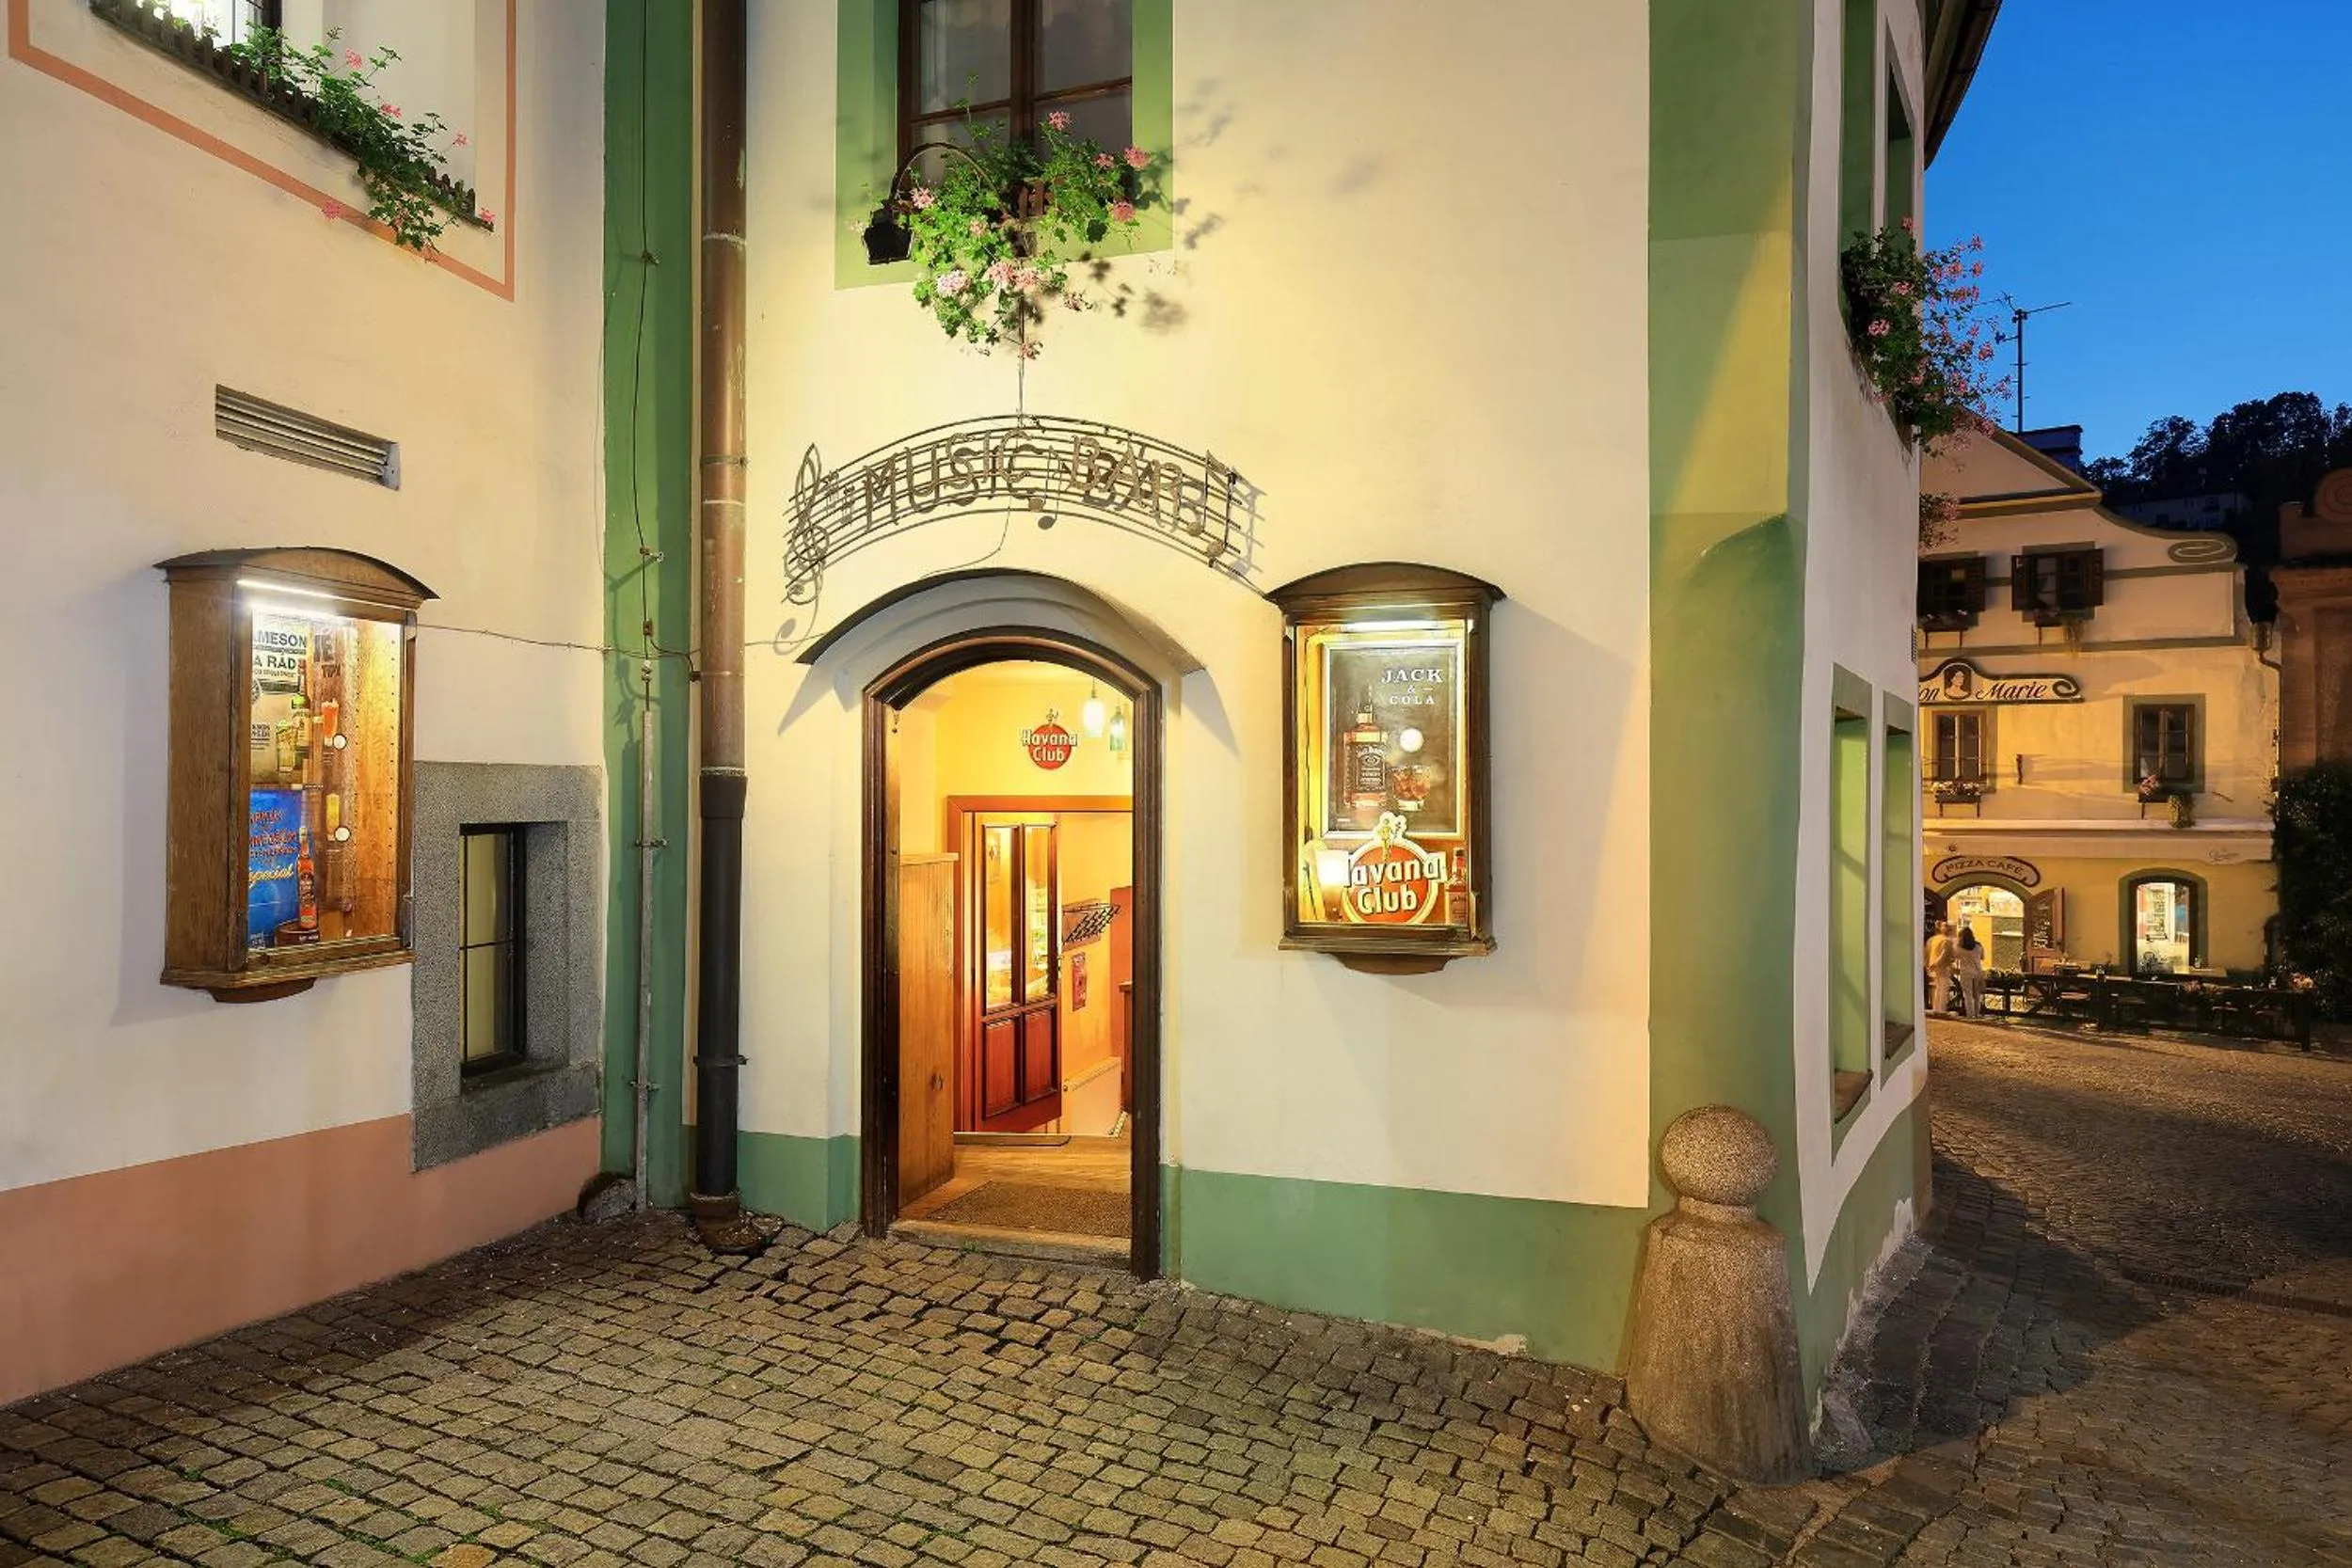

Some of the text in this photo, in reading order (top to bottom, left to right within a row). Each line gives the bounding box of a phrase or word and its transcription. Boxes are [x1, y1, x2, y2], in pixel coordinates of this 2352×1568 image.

[863, 429, 1184, 532] MUSIC BAR
[254, 630, 307, 648] MESON
[1380, 668, 1443, 684] JACK
[1975, 681, 2047, 700] Marie
[1390, 695, 1436, 705] COLA
[1022, 729, 1078, 747] Havana
[1032, 746, 1065, 762] Club
[1343, 858, 1442, 888] avana
[1946, 860, 1984, 872] PIZZA
[1357, 884, 1418, 915] Club
